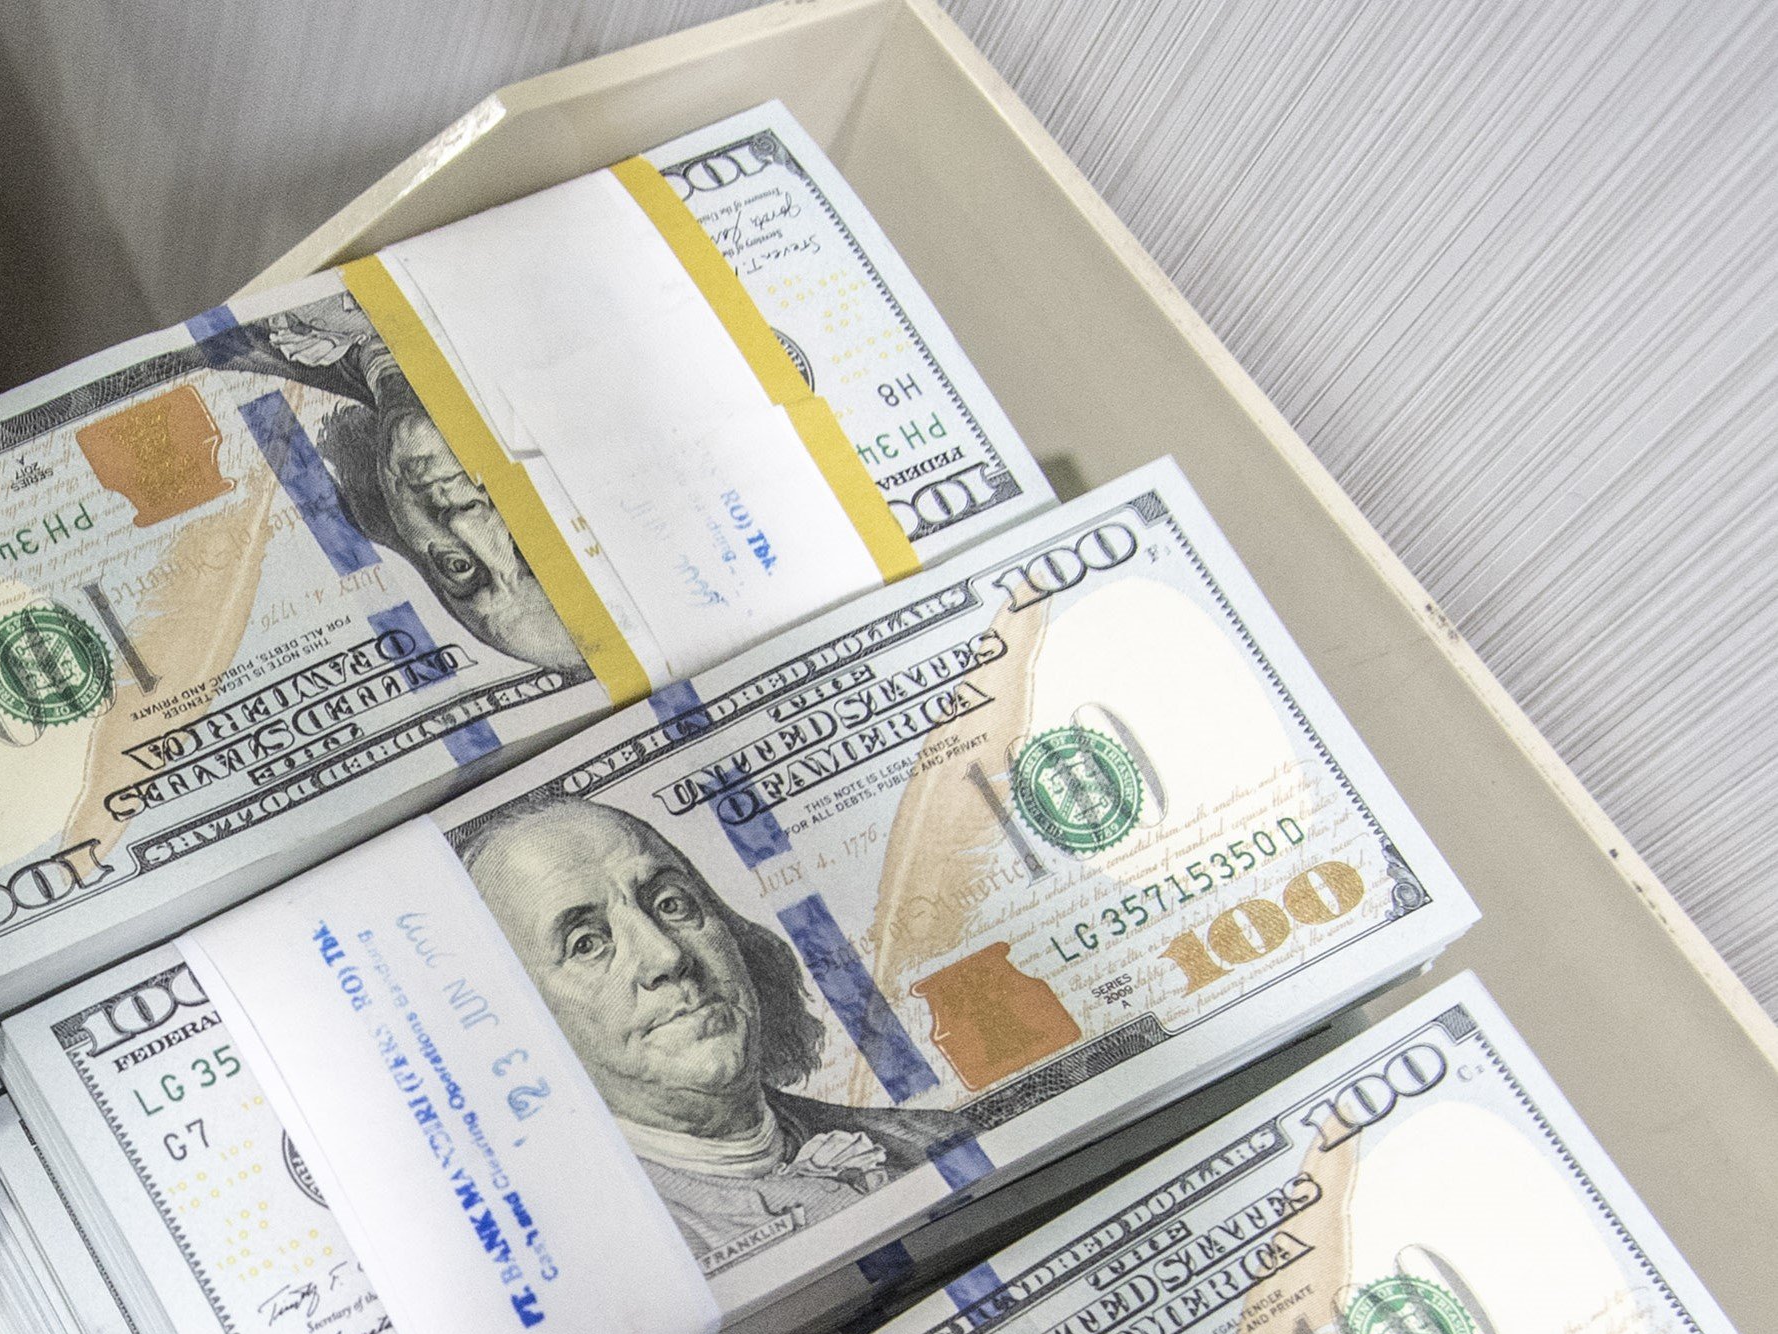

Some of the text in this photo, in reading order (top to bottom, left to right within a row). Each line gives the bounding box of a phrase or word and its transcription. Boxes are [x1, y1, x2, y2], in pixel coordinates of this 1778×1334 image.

[874, 373, 921, 407] H8
[7, 467, 55, 492] SERIES
[10, 460, 41, 479] 2017
[991, 517, 1144, 614] 100
[299, 627, 325, 644] ALL
[324, 614, 351, 632] FOR
[342, 624, 419, 677] OF
[159, 635, 331, 720] THIS NOTE LEGAL TENDER
[177, 679, 208, 699] AND
[206, 658, 254, 686] PUBLIC
[558, 582, 969, 796] ONE HUNDRED DOLLARS
[767, 662, 875, 725] THE
[100, 639, 476, 824] UNITED STATES
[120, 652, 361, 777] AMERICA
[127, 693, 179, 722] PRIVATE
[652, 626, 1009, 818] UNITED STATES
[140, 669, 564, 866] ONE HUNDRED DOLLARS
[246, 722, 364, 785] THE
[712, 772, 791, 829] OF
[775, 672, 994, 798] AMERICA
[803, 732, 961, 814] THIS NOTE LEGAL TENDER
[783, 819, 810, 838] FOR
[809, 806, 835, 825] ALL
[875, 766, 920, 793] PUBLIC
[918, 753, 945, 772] AND
[944, 731, 991, 760] PRIVATE
[1154, 852, 1373, 997] 100
[440, 971, 502, 1038] JUN
[1090, 971, 1133, 999] SERIES
[1102, 983, 1135, 1006] 2009
[1298, 1037, 1454, 1153] 100
[161, 1118, 215, 1163] G7
[700, 1217, 789, 1270] FRANKLIN
[955, 1220, 1128, 1334] HUNDRED
[1122, 1125, 1279, 1231] DOLLARS
[1086, 1218, 1192, 1292] THE
[1150, 1170, 1324, 1293] STATES
[305, 1302, 353, 1334] Secretary
[1238, 1288, 1285, 1323] TENDER
[1243, 1311, 1270, 1334] AND
[1269, 1284, 1315, 1318] PRIVATE
